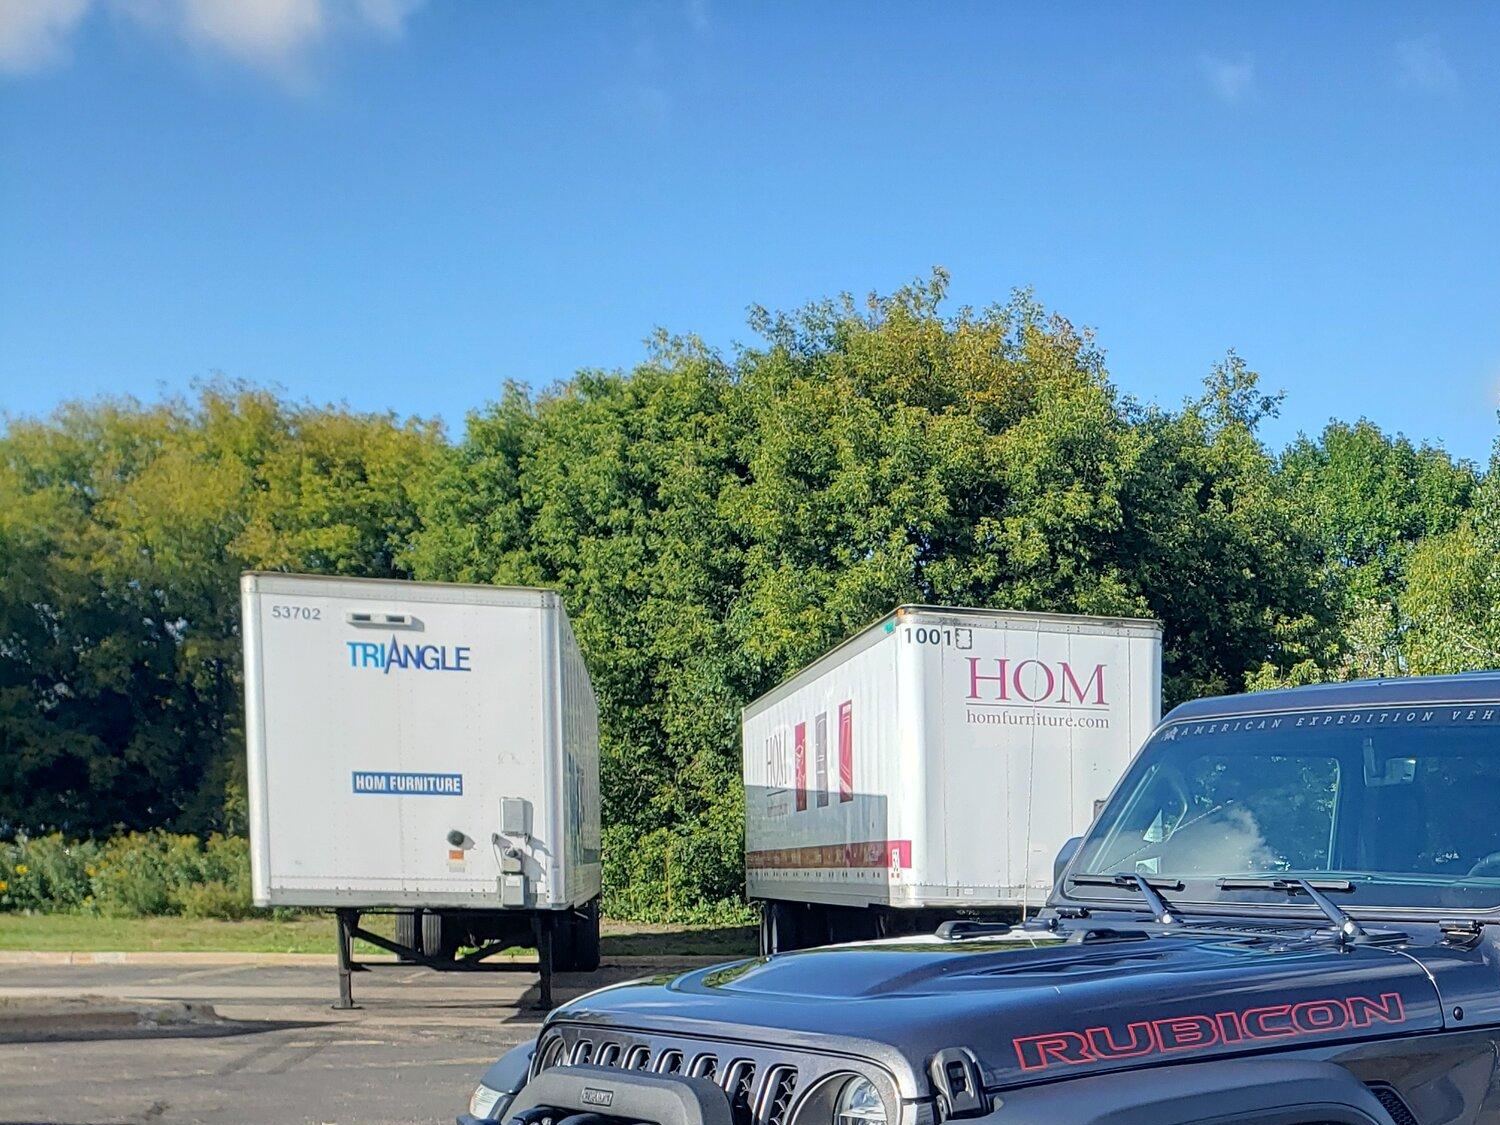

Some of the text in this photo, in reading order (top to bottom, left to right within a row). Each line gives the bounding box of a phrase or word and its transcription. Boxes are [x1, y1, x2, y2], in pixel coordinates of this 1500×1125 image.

[272, 605, 321, 620] 53702
[904, 627, 952, 646] 1001
[346, 633, 471, 675] TRIANGLE
[964, 656, 1110, 706] HOM
[966, 709, 1110, 729] homfurniture.com
[1181, 718, 1282, 737] AMERICAN
[1296, 711, 1434, 728] EXPEDITION
[355, 774, 461, 793] HOM FURNITURE
[1013, 992, 1405, 1071] RUBICON
